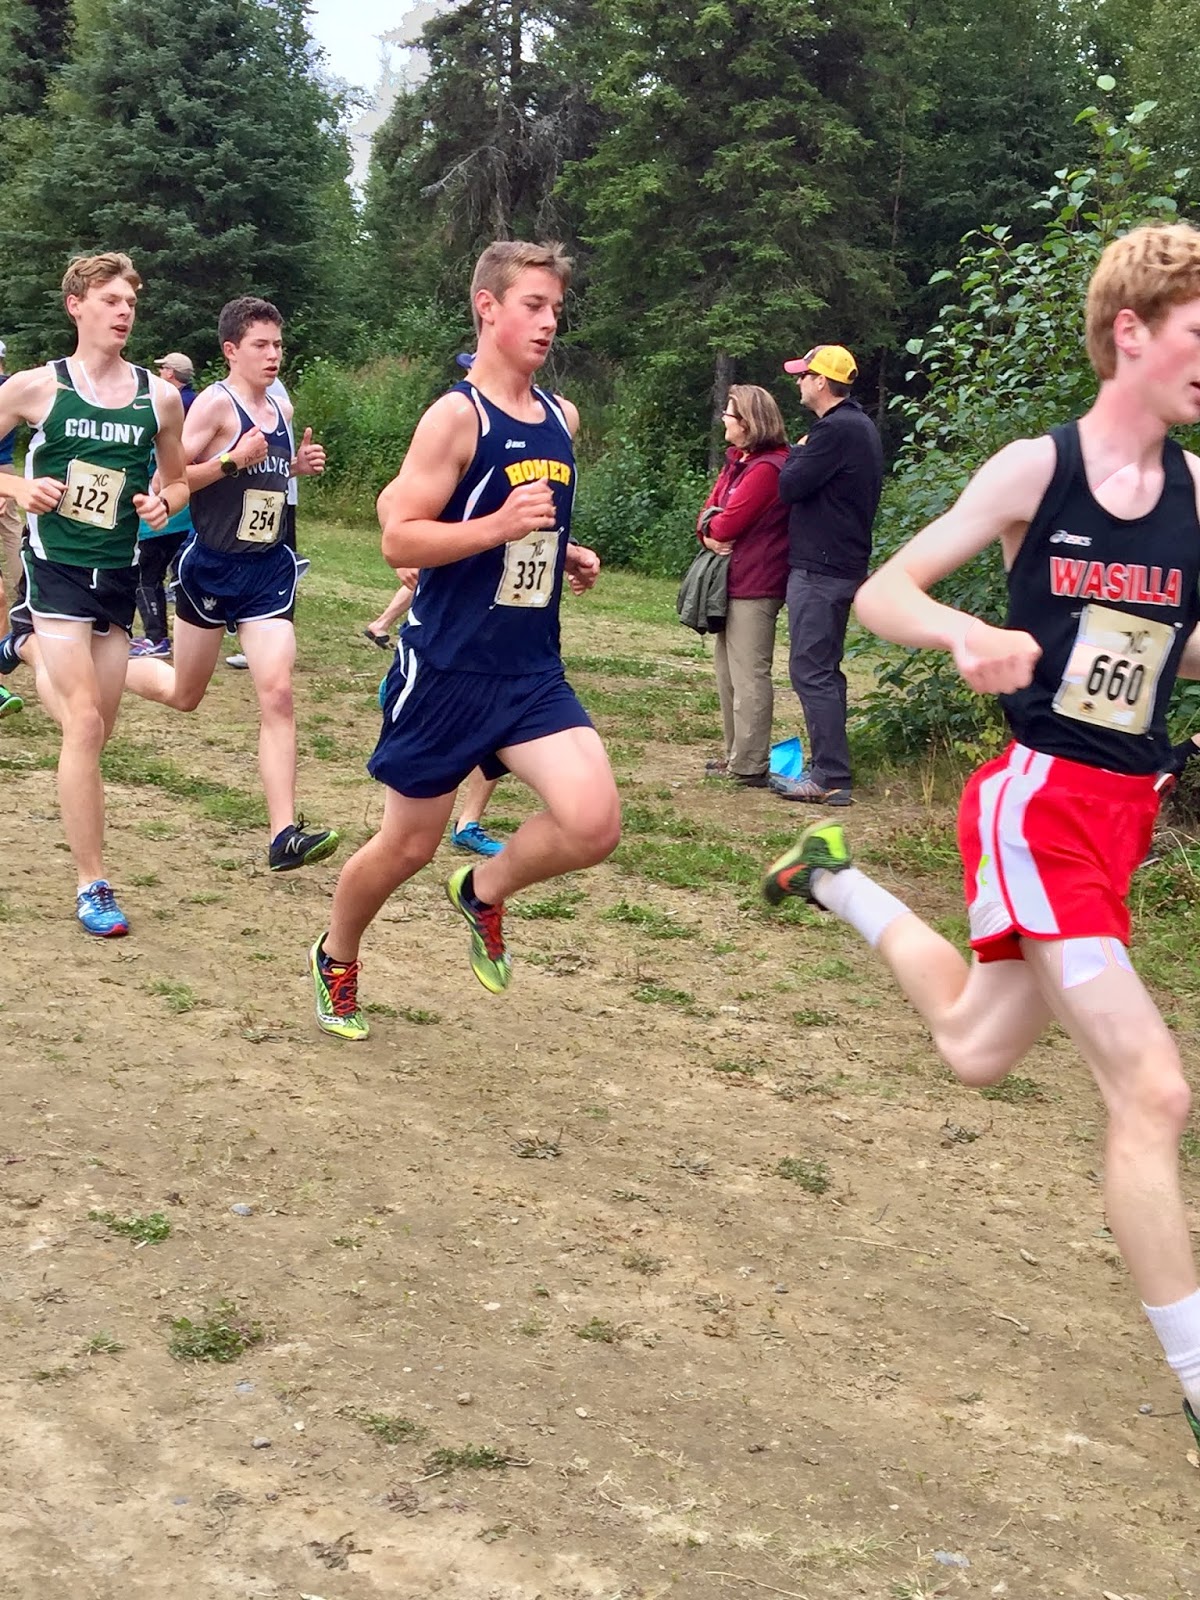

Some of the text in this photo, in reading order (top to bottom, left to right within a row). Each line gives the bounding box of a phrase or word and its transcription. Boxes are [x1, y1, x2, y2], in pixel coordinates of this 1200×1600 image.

[65, 419, 145, 446] COLONY
[90, 474, 110, 487] XC
[504, 459, 571, 487] HOMER
[72, 485, 109, 514] 122
[249, 510, 275, 531] 254
[513, 560, 547, 590] 337
[1050, 556, 1182, 608] WASILLA
[1087, 654, 1145, 706] 660
